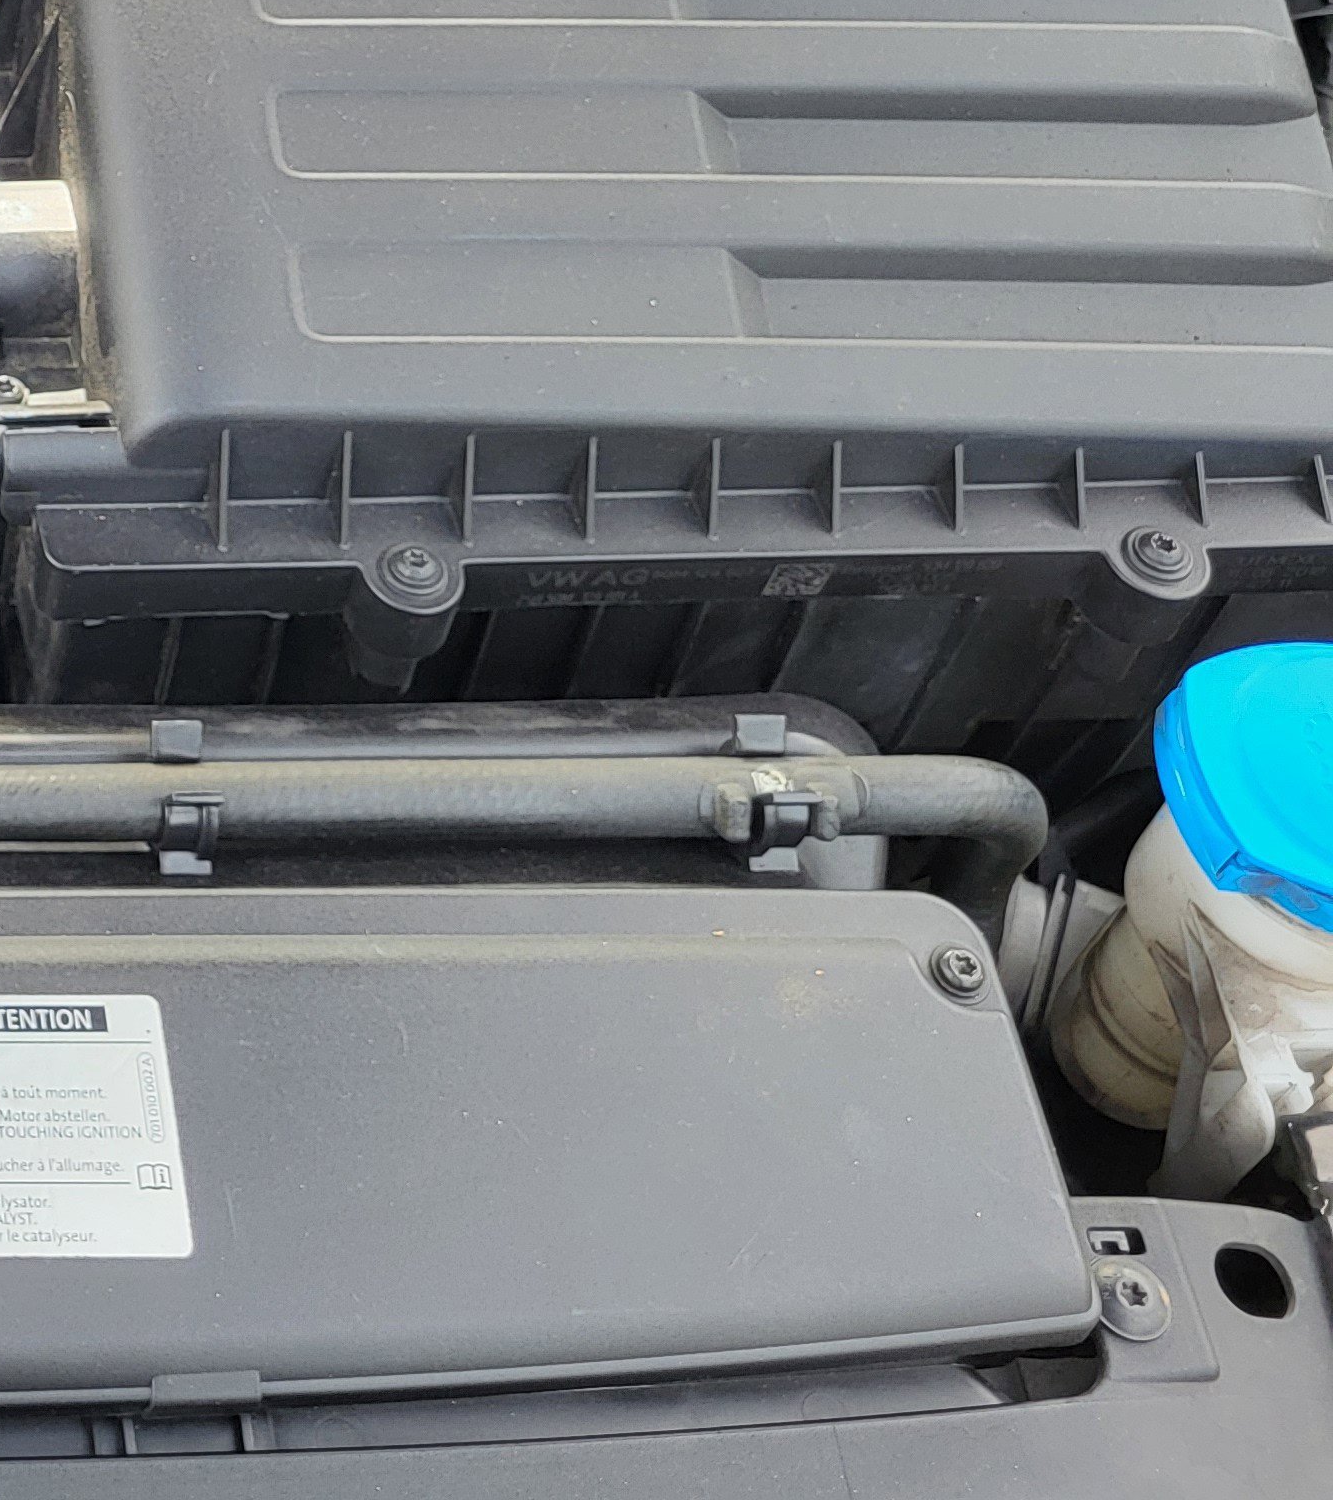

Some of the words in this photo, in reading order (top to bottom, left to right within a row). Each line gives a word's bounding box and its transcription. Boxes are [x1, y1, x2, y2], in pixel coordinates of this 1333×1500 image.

[45, 1087, 106, 1099] moment.
[43, 1108, 110, 1122] abstellen.
[77, 1125, 142, 1139] IGNITION
[48, 1158, 124, 1176] l'allumage.
[6, 1228, 20, 1242] le
[21, 1228, 97, 1246] catalyseur.
